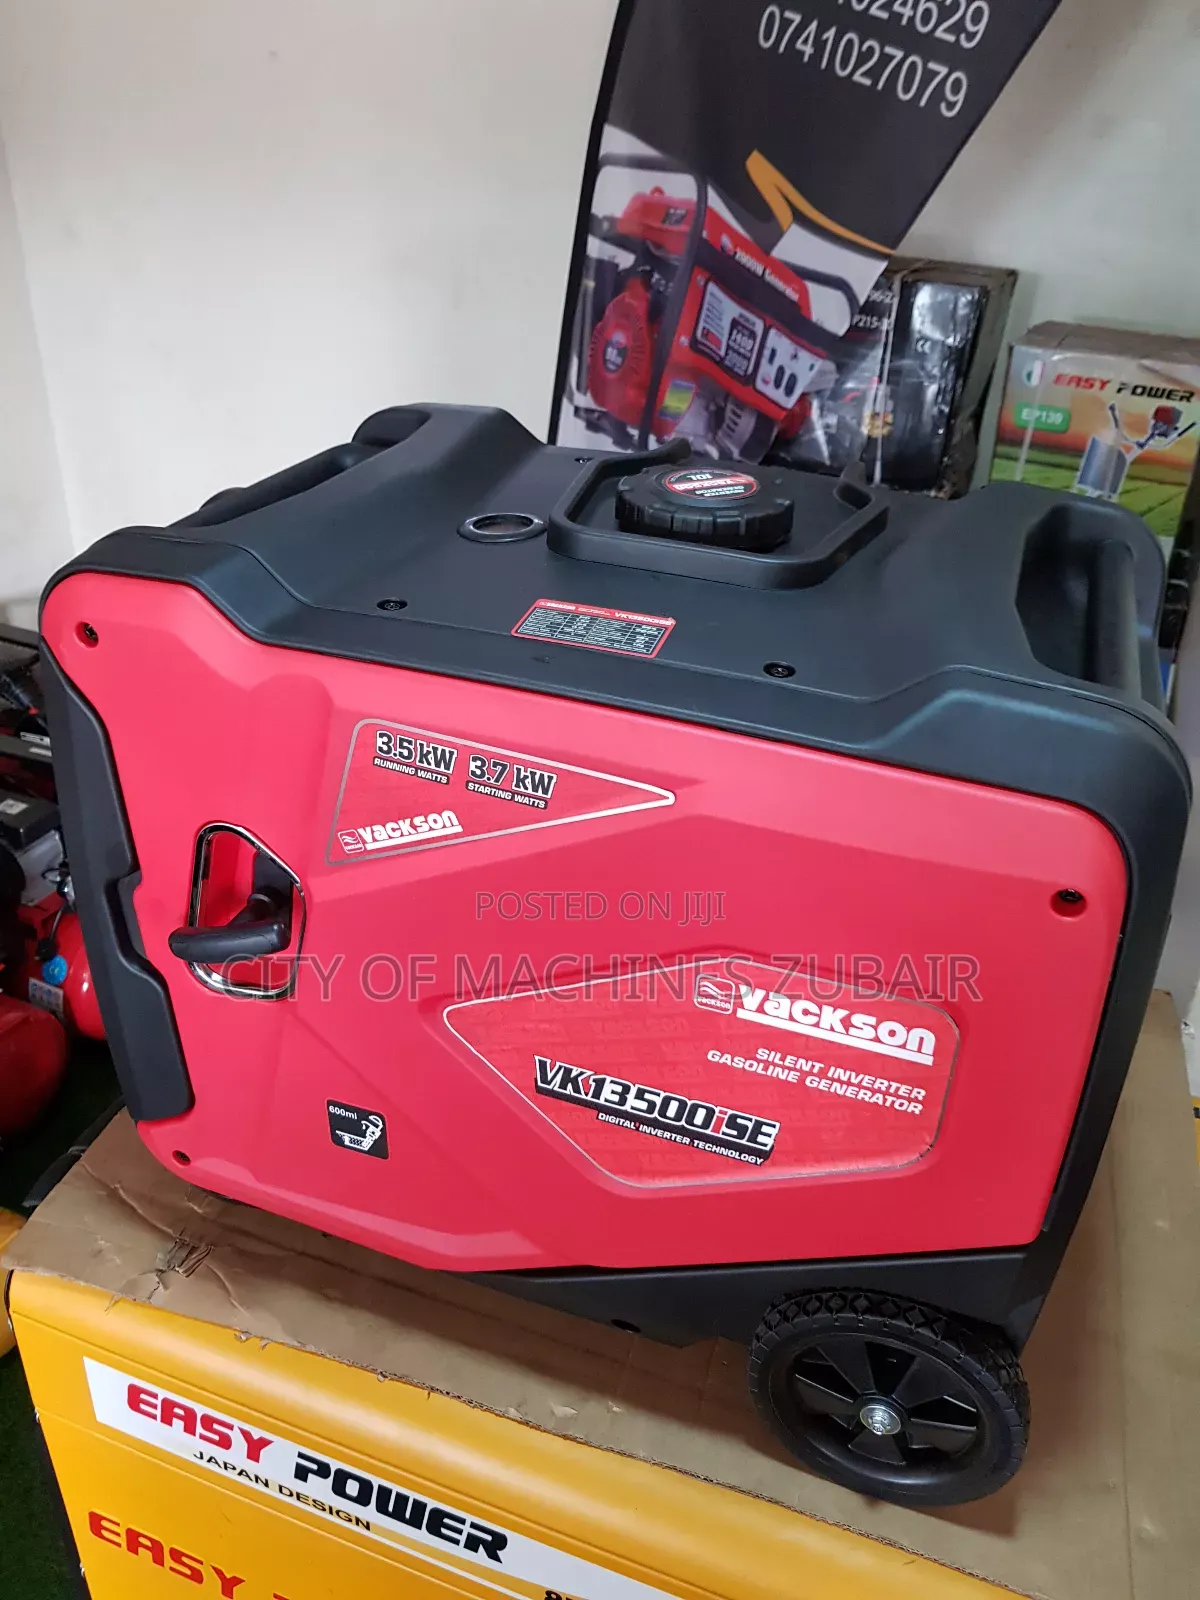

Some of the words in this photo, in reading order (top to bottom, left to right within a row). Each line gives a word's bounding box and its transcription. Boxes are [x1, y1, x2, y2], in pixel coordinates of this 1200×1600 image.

[758, 5, 968, 118] 0741027079
[1053, 373, 1112, 391] EASY
[1116, 382, 1196, 403] POWER
[374, 758, 416, 775] RUNNING
[417, 769, 448, 784] WATTS
[467, 782, 512, 800] STARTING
[514, 793, 546, 809] WATTS
[469, 754, 509, 785] 3.7
[512, 764, 557, 799] kW
[707, 1049, 801, 1083] GASOLINE
[804, 1076, 923, 1115] GENERATOR
[756, 1047, 824, 1072] SILENT
[827, 1066, 926, 1101] INVERTER
[329, 1105, 358, 1120] 600ml
[598, 1112, 637, 1130] DIGITAL
[639, 1124, 690, 1145] INVERTER
[692, 1139, 764, 1166] TECHNOLOGY
[127, 1383, 274, 1464] EASY
[293, 1451, 509, 1564] POWER
[193, 1451, 270, 1489] JAPAN
[276, 1483, 372, 1532] DESIGN
[88, 1510, 246, 1600] EASY
